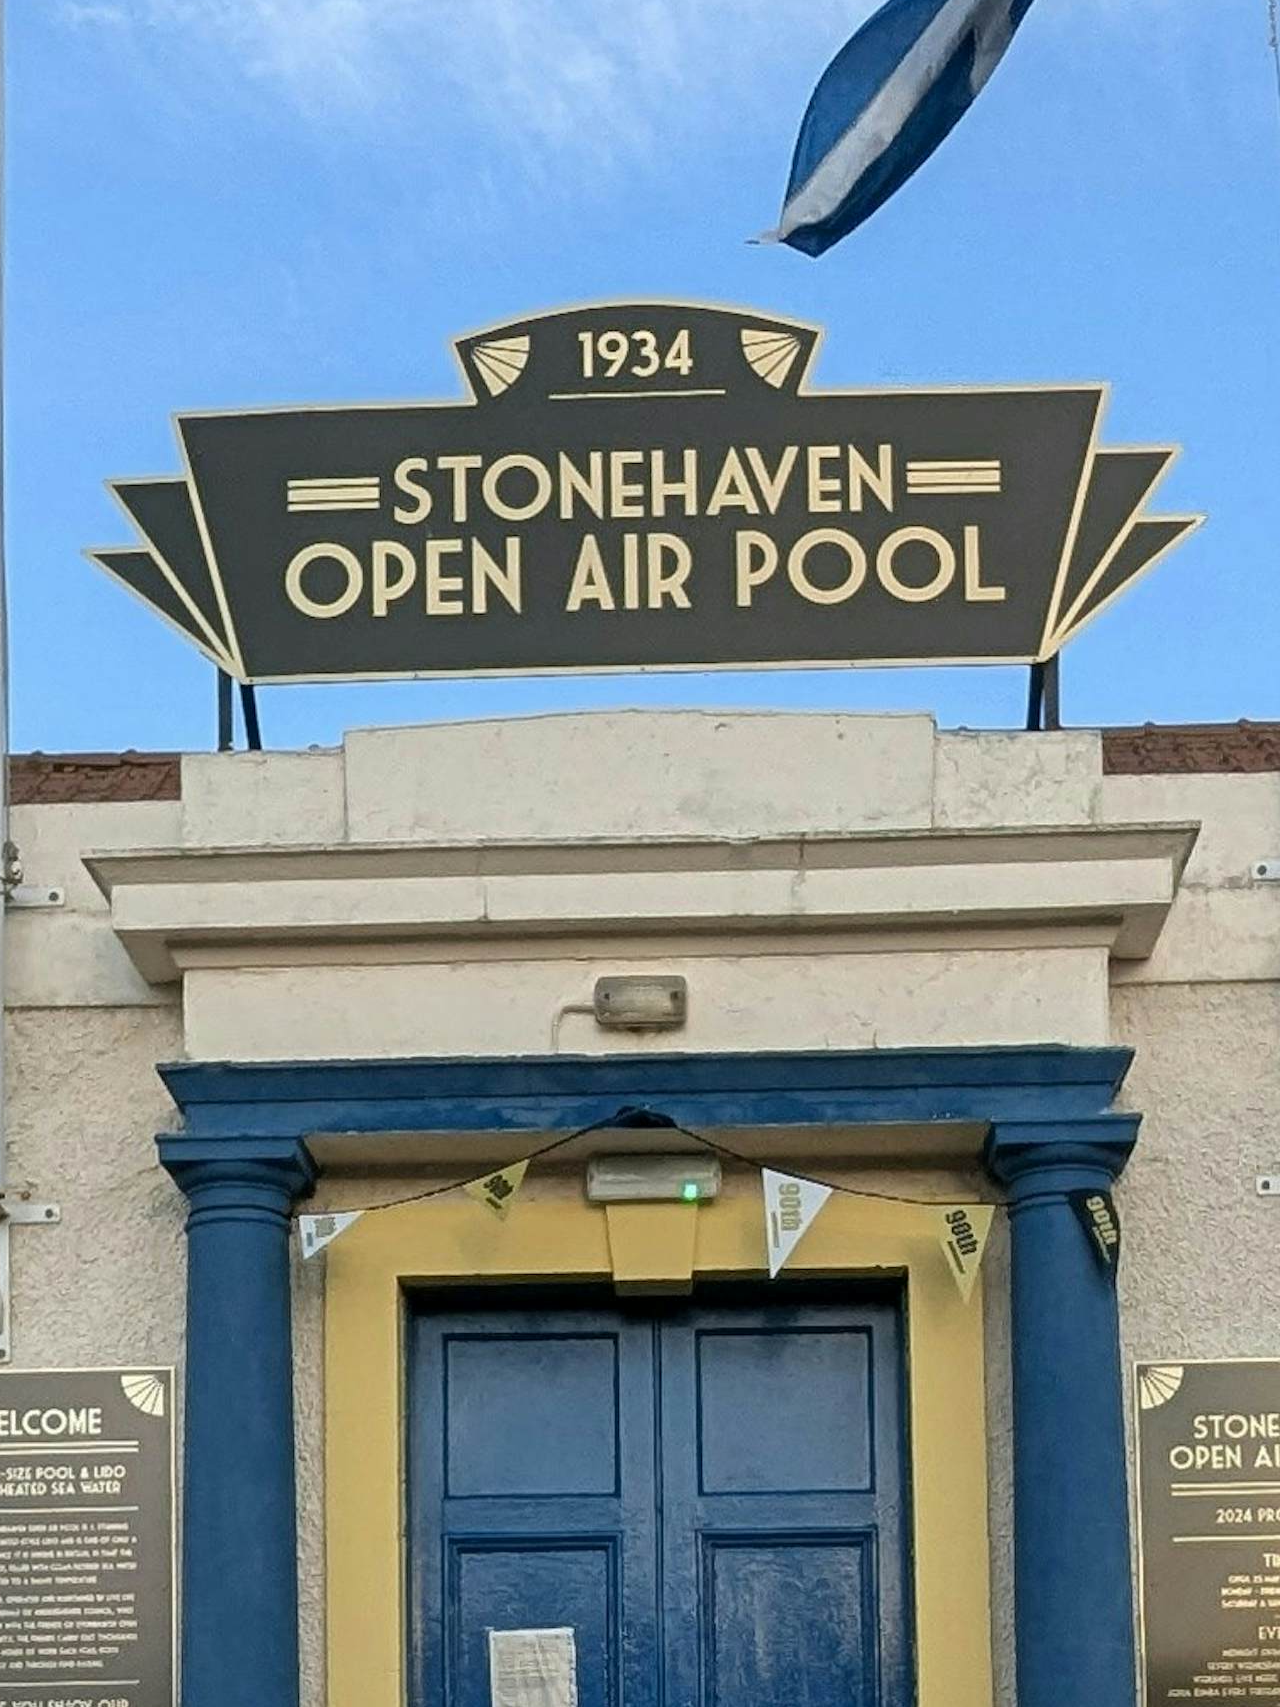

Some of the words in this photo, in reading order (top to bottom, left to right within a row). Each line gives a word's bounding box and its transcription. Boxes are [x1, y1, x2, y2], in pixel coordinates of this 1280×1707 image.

[577, 330, 694, 379] 1934
[392, 443, 894, 525] STONEHAVEN
[285, 535, 522, 618] OPEN
[565, 531, 693, 612] AIR
[735, 525, 1007, 608] POOL
[945, 1209, 979, 1256] 90th
[35, 1465, 76, 1481] POOL
[79, 1466, 90, 1481] &
[93, 1464, 127, 1480] LIDO
[1168, 1444, 1243, 1470] OPEN
[0, 1481, 47, 1497] HEATED
[50, 1480, 76, 1495] SEA
[80, 1480, 122, 1494] WATER
[1215, 1506, 1253, 1524] 2024
